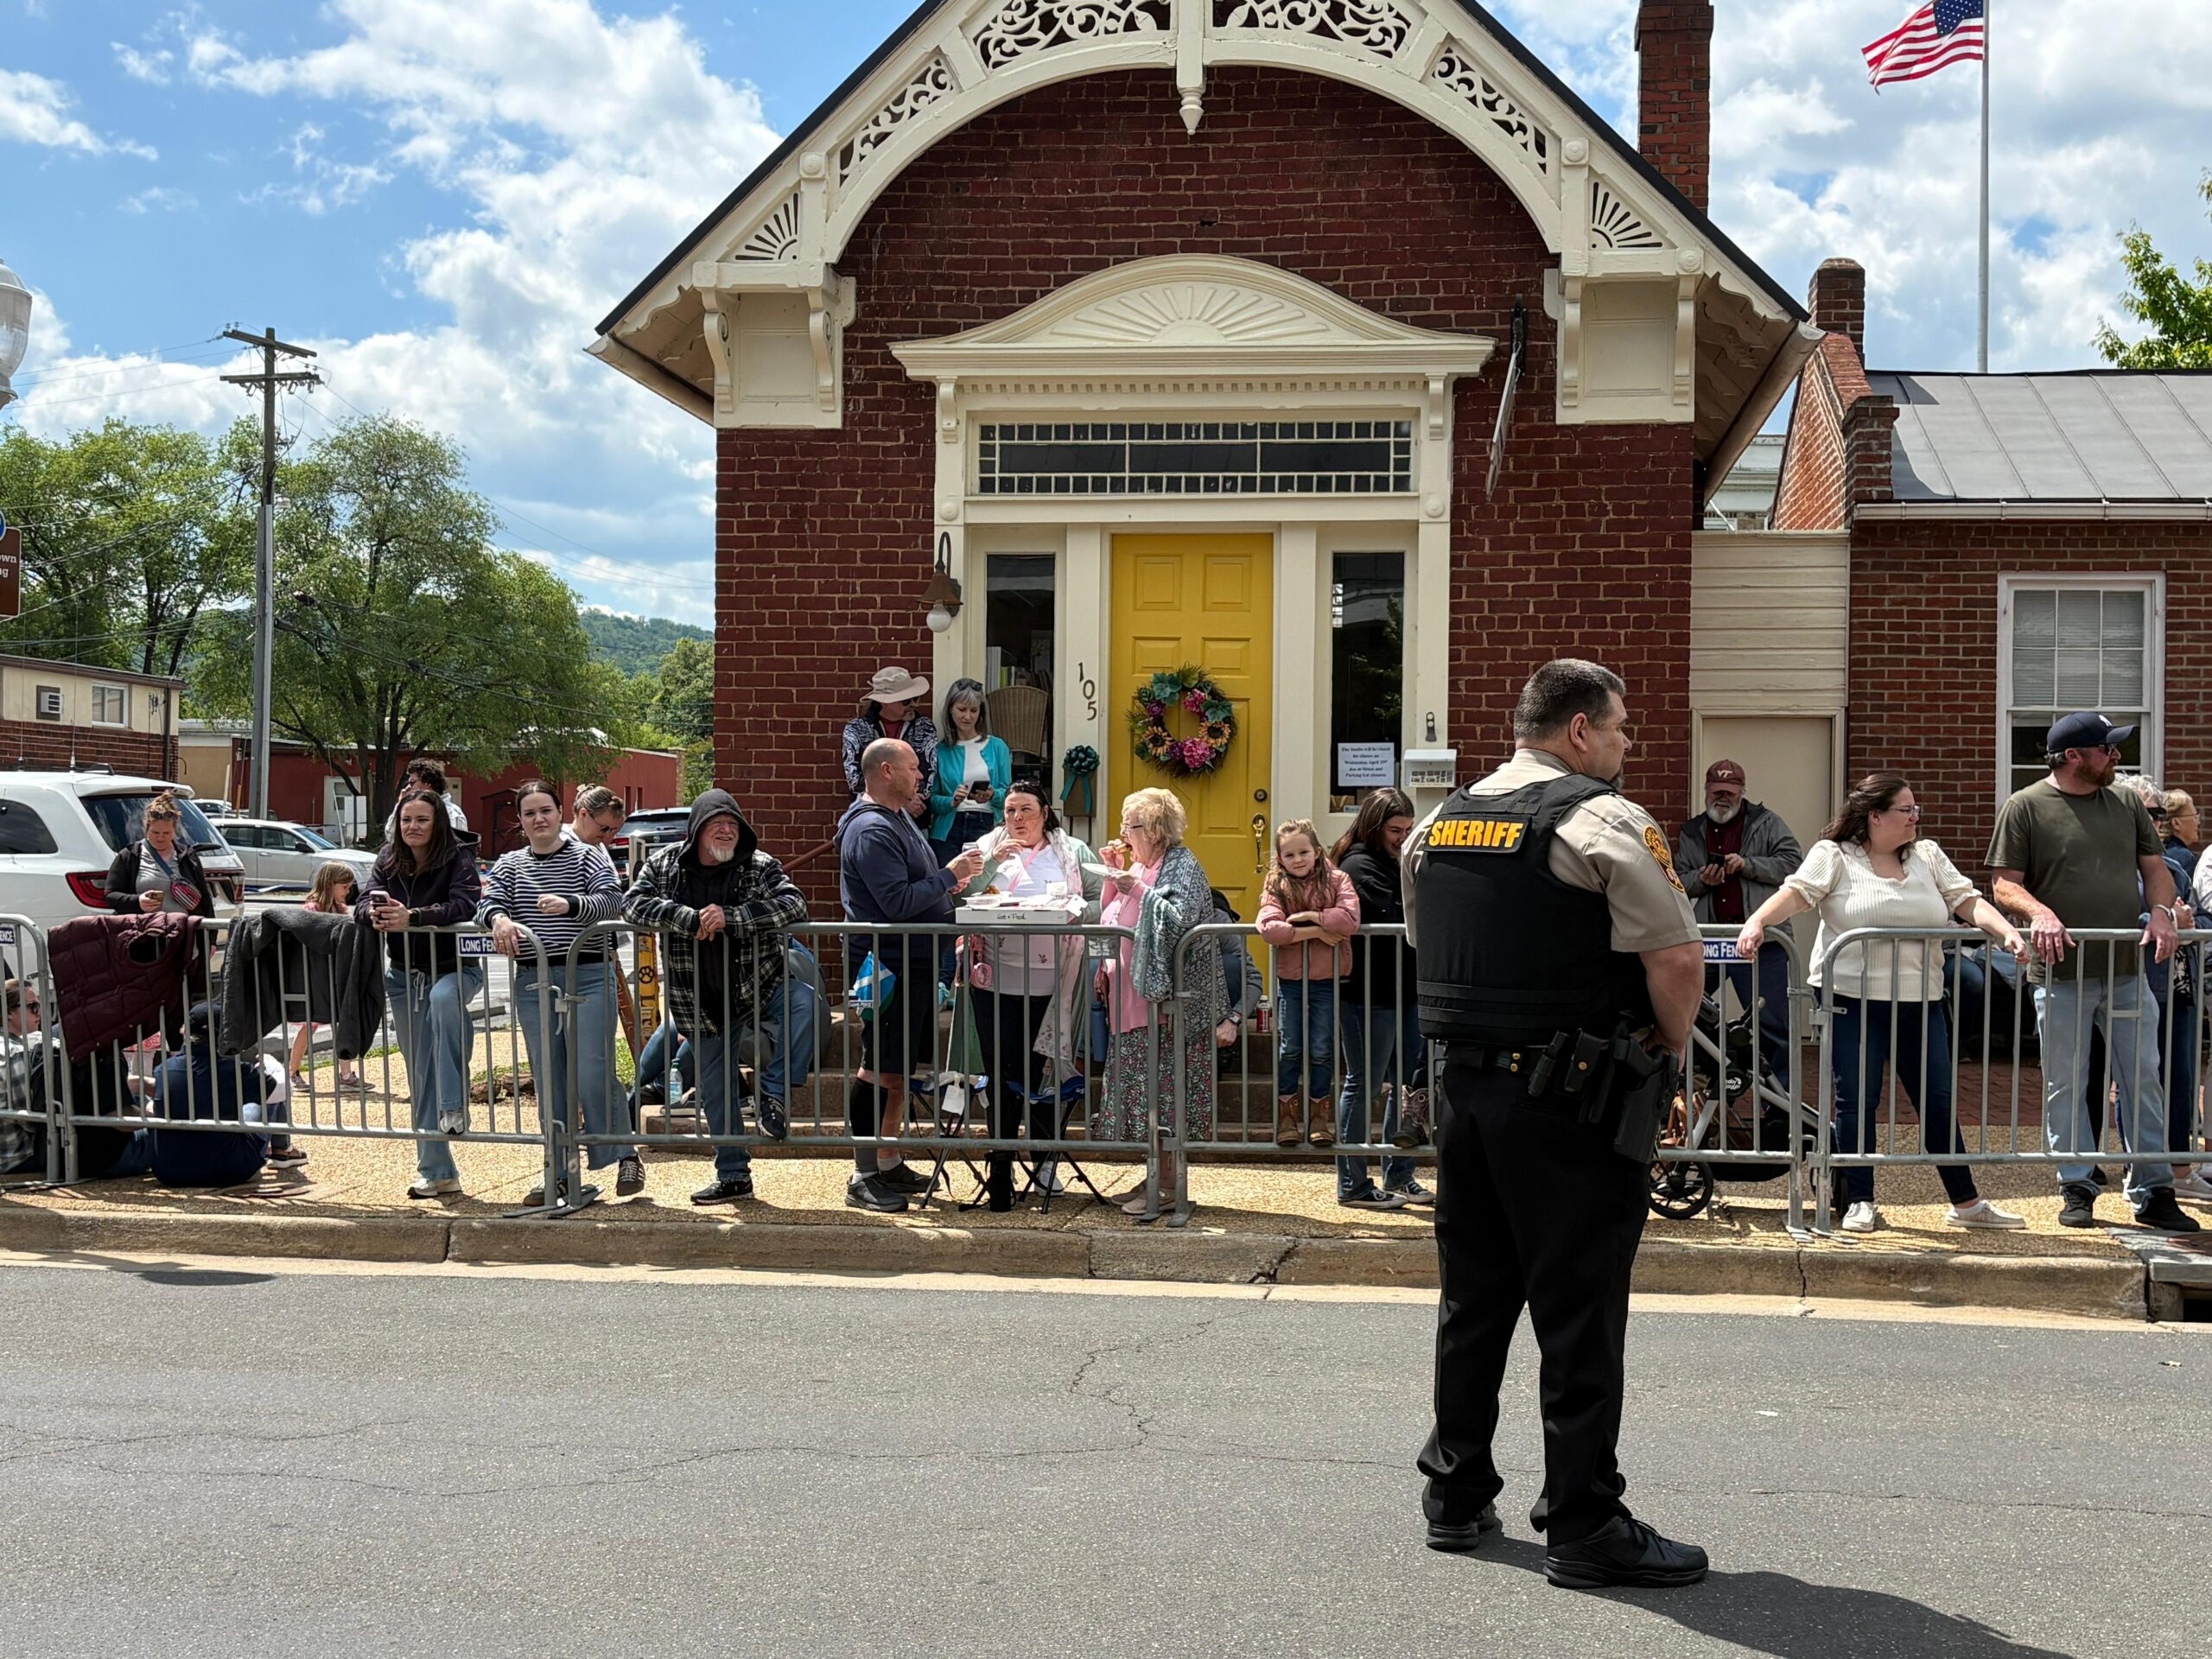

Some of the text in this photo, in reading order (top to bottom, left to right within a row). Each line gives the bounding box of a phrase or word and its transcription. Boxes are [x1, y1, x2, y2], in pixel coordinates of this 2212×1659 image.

[1077, 662, 1097, 721] 105
[1428, 820, 1523, 848] SHERIFF
[461, 938, 480, 952] LONG
